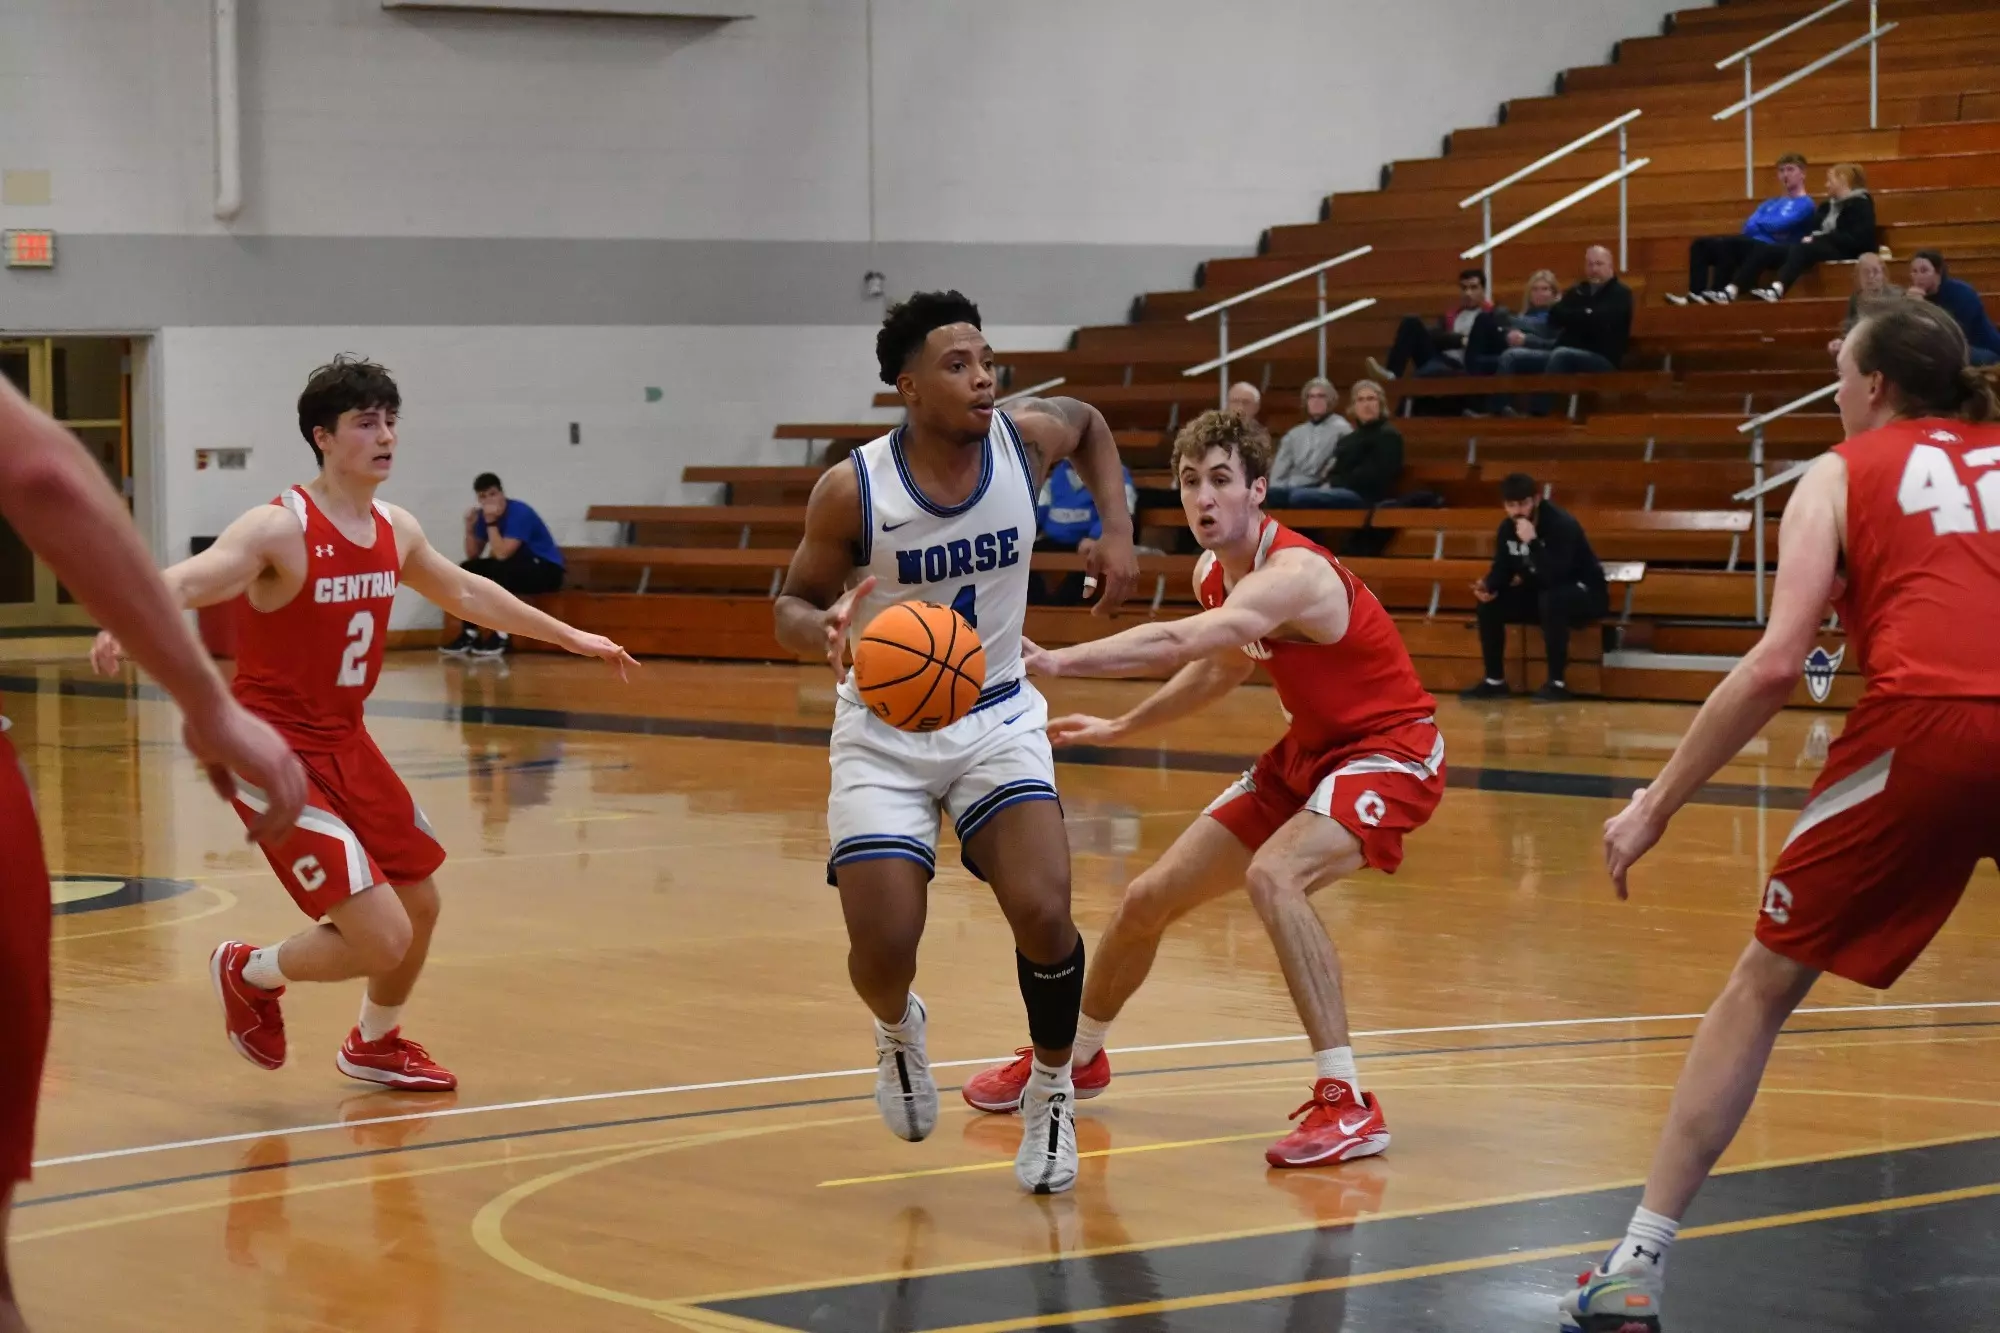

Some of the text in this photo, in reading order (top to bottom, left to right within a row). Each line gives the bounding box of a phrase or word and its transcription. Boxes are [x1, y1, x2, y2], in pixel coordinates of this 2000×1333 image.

[896, 526, 1019, 585] NORSE
[335, 610, 375, 687] 2
[292, 854, 327, 892] C
